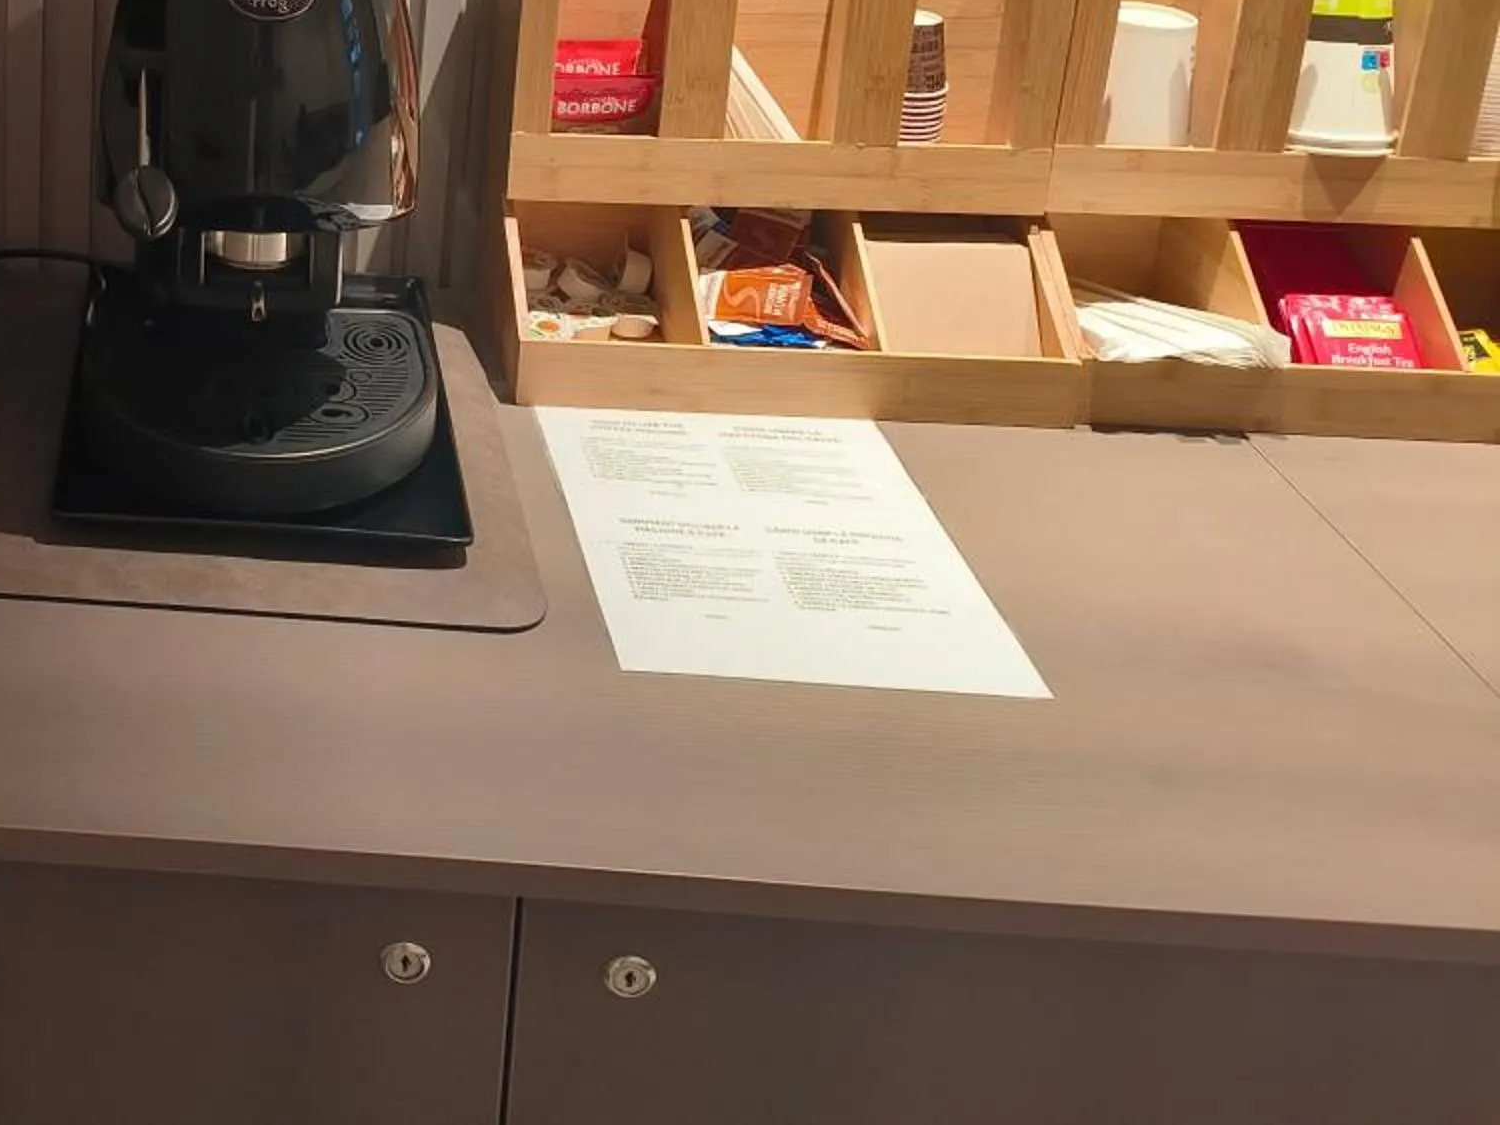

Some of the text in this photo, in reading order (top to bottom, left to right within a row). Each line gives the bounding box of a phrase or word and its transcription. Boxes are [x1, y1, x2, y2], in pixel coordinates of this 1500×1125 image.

[555, 61, 621, 76] ORBONE
[557, 98, 638, 116] BORBONE
[1347, 341, 1393, 357] English
